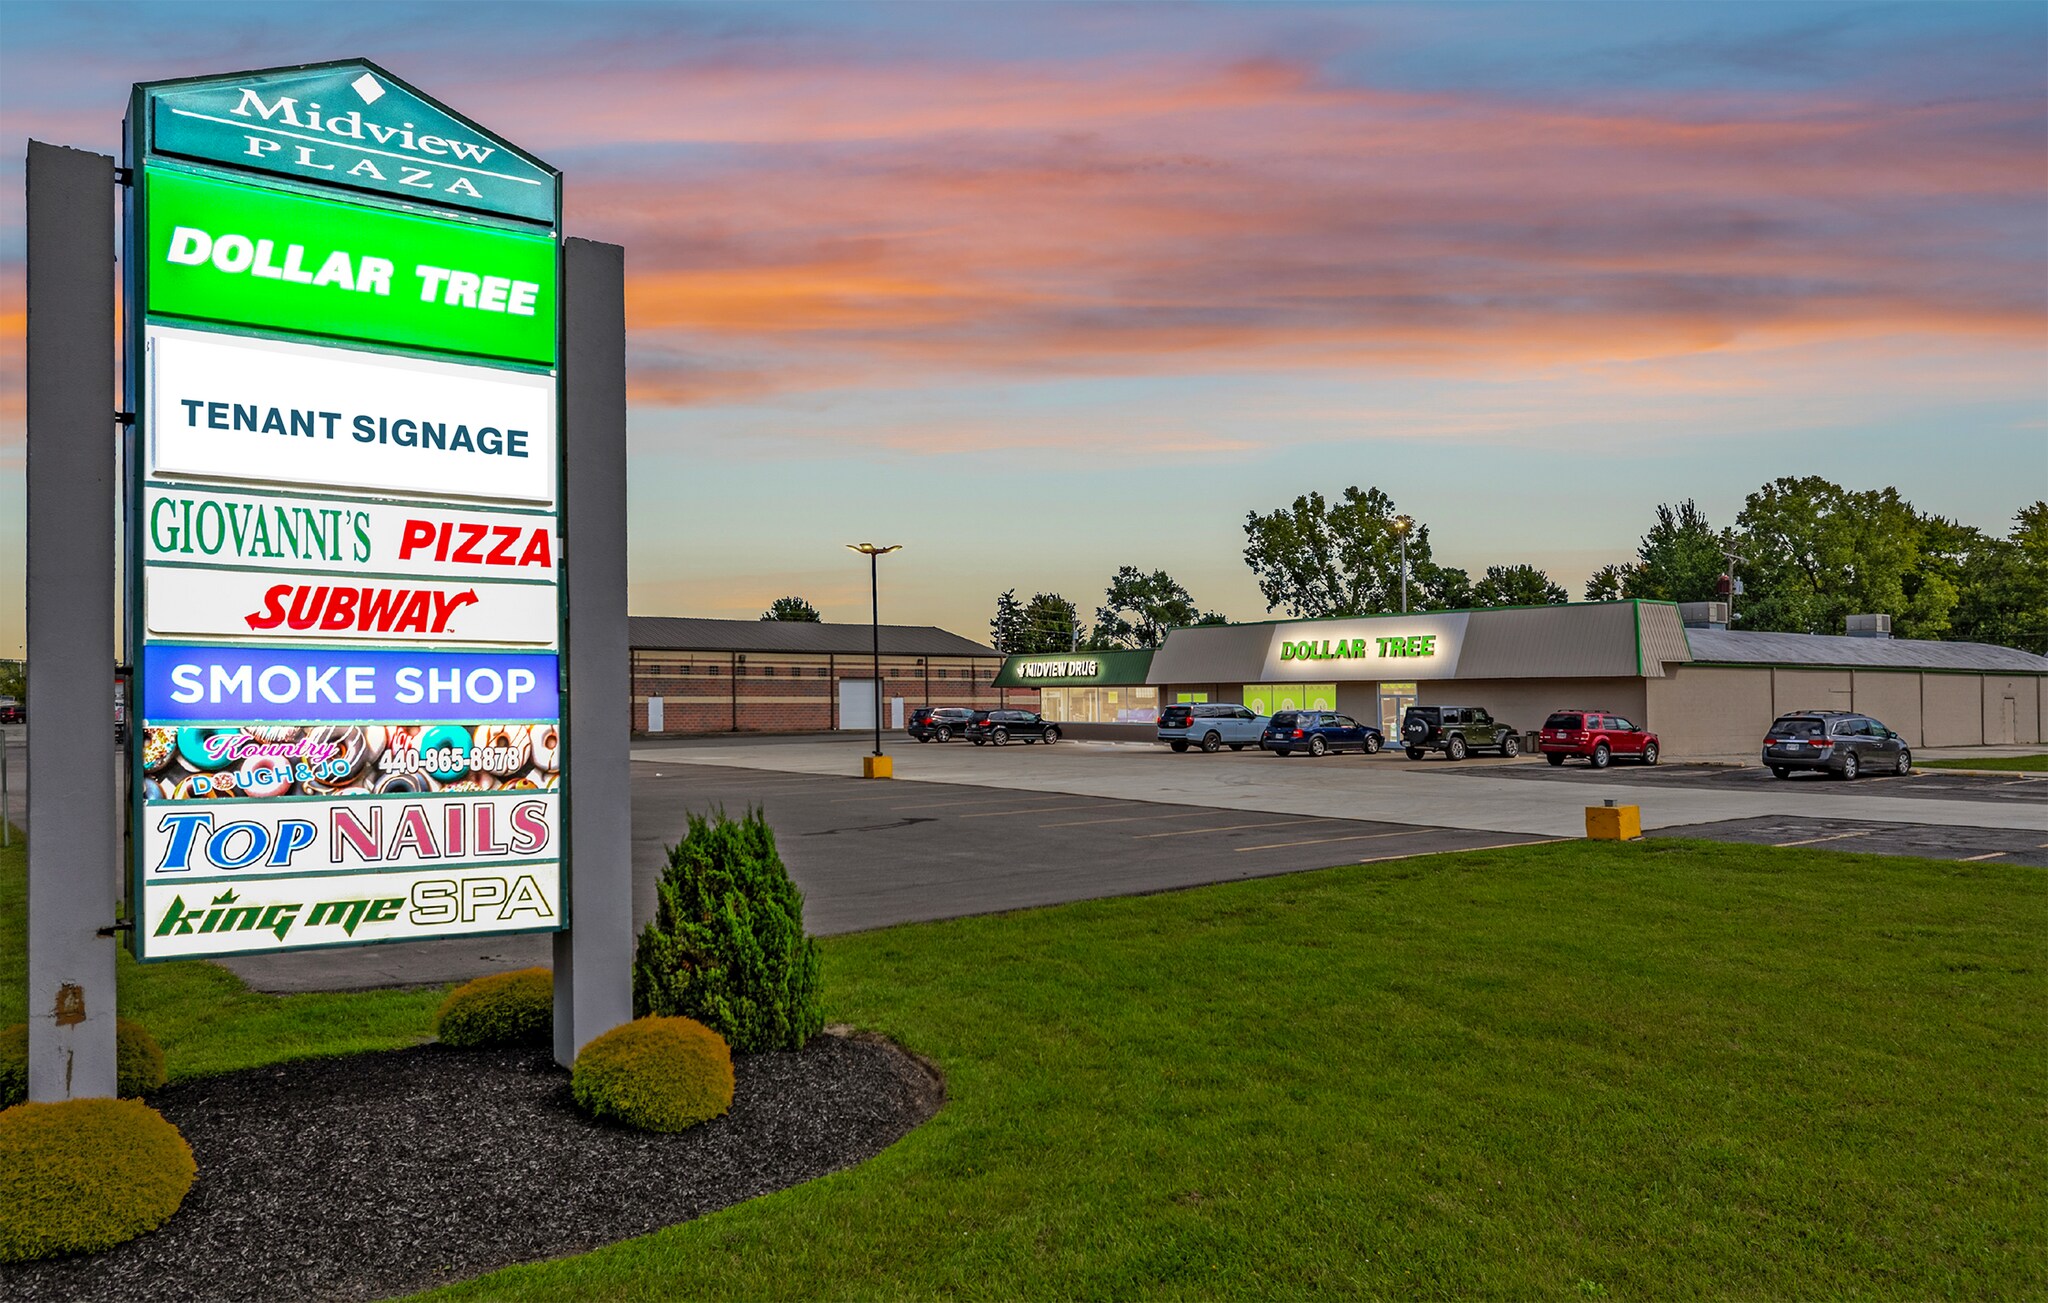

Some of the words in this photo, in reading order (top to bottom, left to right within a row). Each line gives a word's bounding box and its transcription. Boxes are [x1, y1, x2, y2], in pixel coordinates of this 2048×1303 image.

[230, 88, 495, 163] Midview
[244, 135, 482, 198] PLAZA
[167, 226, 394, 295] DOLLAR
[416, 264, 539, 315] TREE
[181, 399, 341, 439] TENANT
[352, 415, 529, 458] SIGNAGE
[151, 497, 371, 563] GIOVANNI'S
[399, 519, 551, 567] PIZZA
[244, 584, 479, 633] SUBWAY
[1025, 661, 1067, 678] MIDVIEW
[1068, 660, 1098, 676] DRUG
[1280, 639, 1366, 661] DOLLAR
[1376, 635, 1436, 658] TREE
[170, 664, 375, 704] SMOKE
[395, 668, 536, 704] SHOP
[204, 734, 337, 763] Kountry
[379, 747, 520, 773] 440-865-8878
[330, 800, 550, 863] NAILS
[153, 889, 302, 942] king
[305, 897, 407, 937] me
[410, 875, 554, 926] SPA
